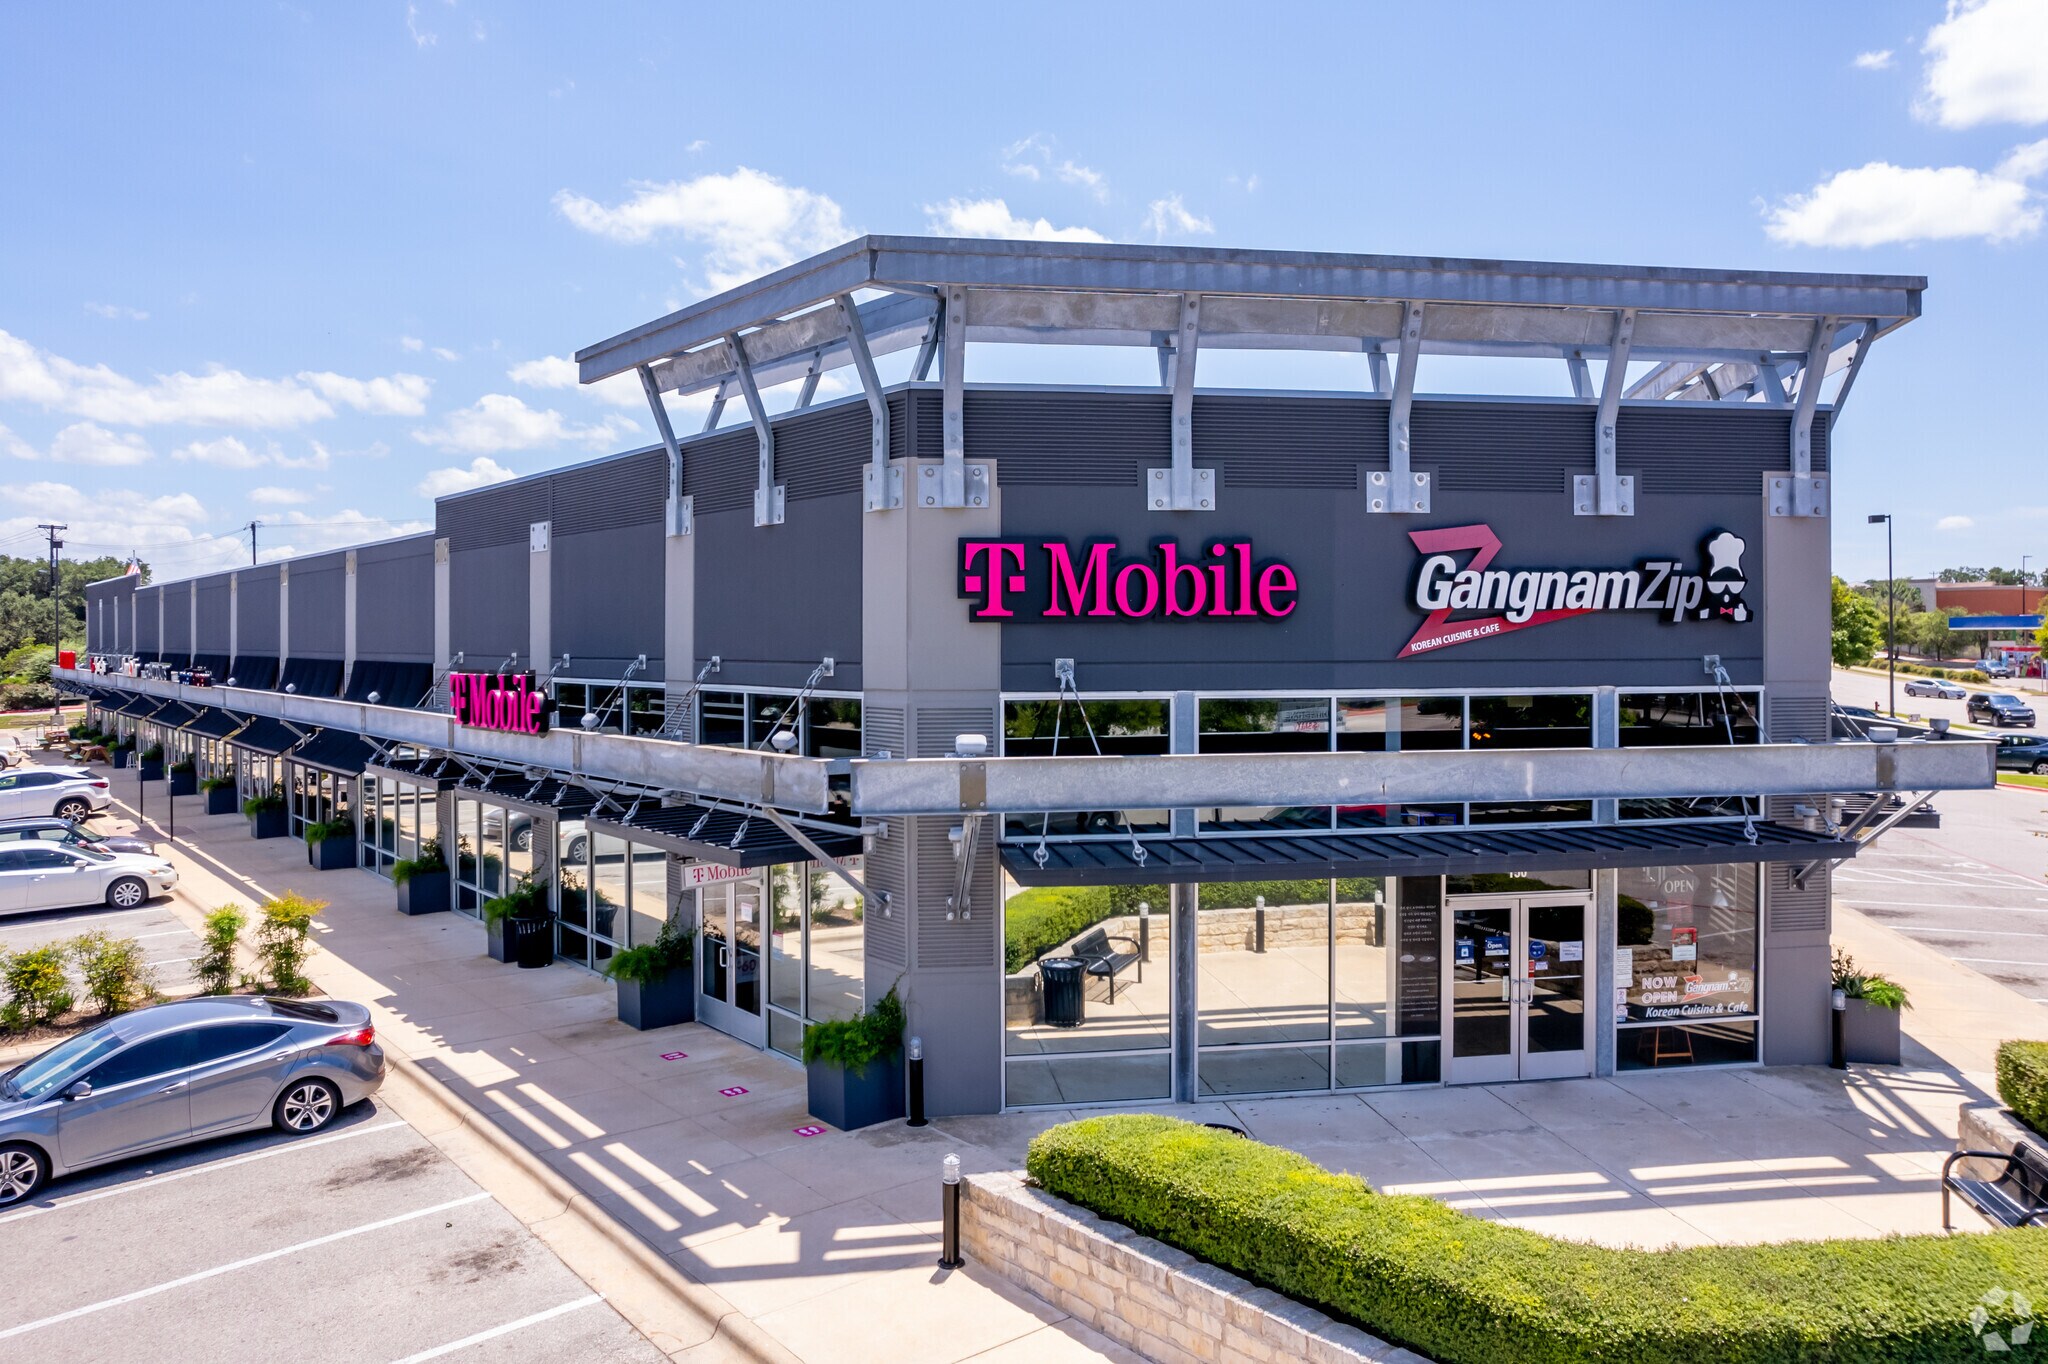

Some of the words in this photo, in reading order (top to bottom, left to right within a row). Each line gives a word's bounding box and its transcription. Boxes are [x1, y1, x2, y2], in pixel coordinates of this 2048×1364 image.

[965, 543, 1025, 617] T
[1043, 543, 1297, 617] Mobile
[1411, 637, 1442, 652] KOREAN
[1443, 629, 1472, 644] CUISINE
[1473, 627, 1479, 637] &
[1480, 623, 1500, 635] CAFE
[449, 674, 467, 725] T
[468, 674, 541, 735] Mobile
[693, 867, 704, 883] T
[1664, 879, 1695, 894] OPEN
[1487, 942, 1503, 950] Open
[1641, 976, 1678, 989] NOW
[1685, 982, 1728, 994] Gangnam
[1641, 991, 1678, 1004] OPEN
[1645, 1006, 1679, 1018] Korean
[1681, 1004, 1714, 1016] Cuisine
[1716, 1002, 1723, 1013] &
[1727, 1001, 1748, 1013] Cafe
